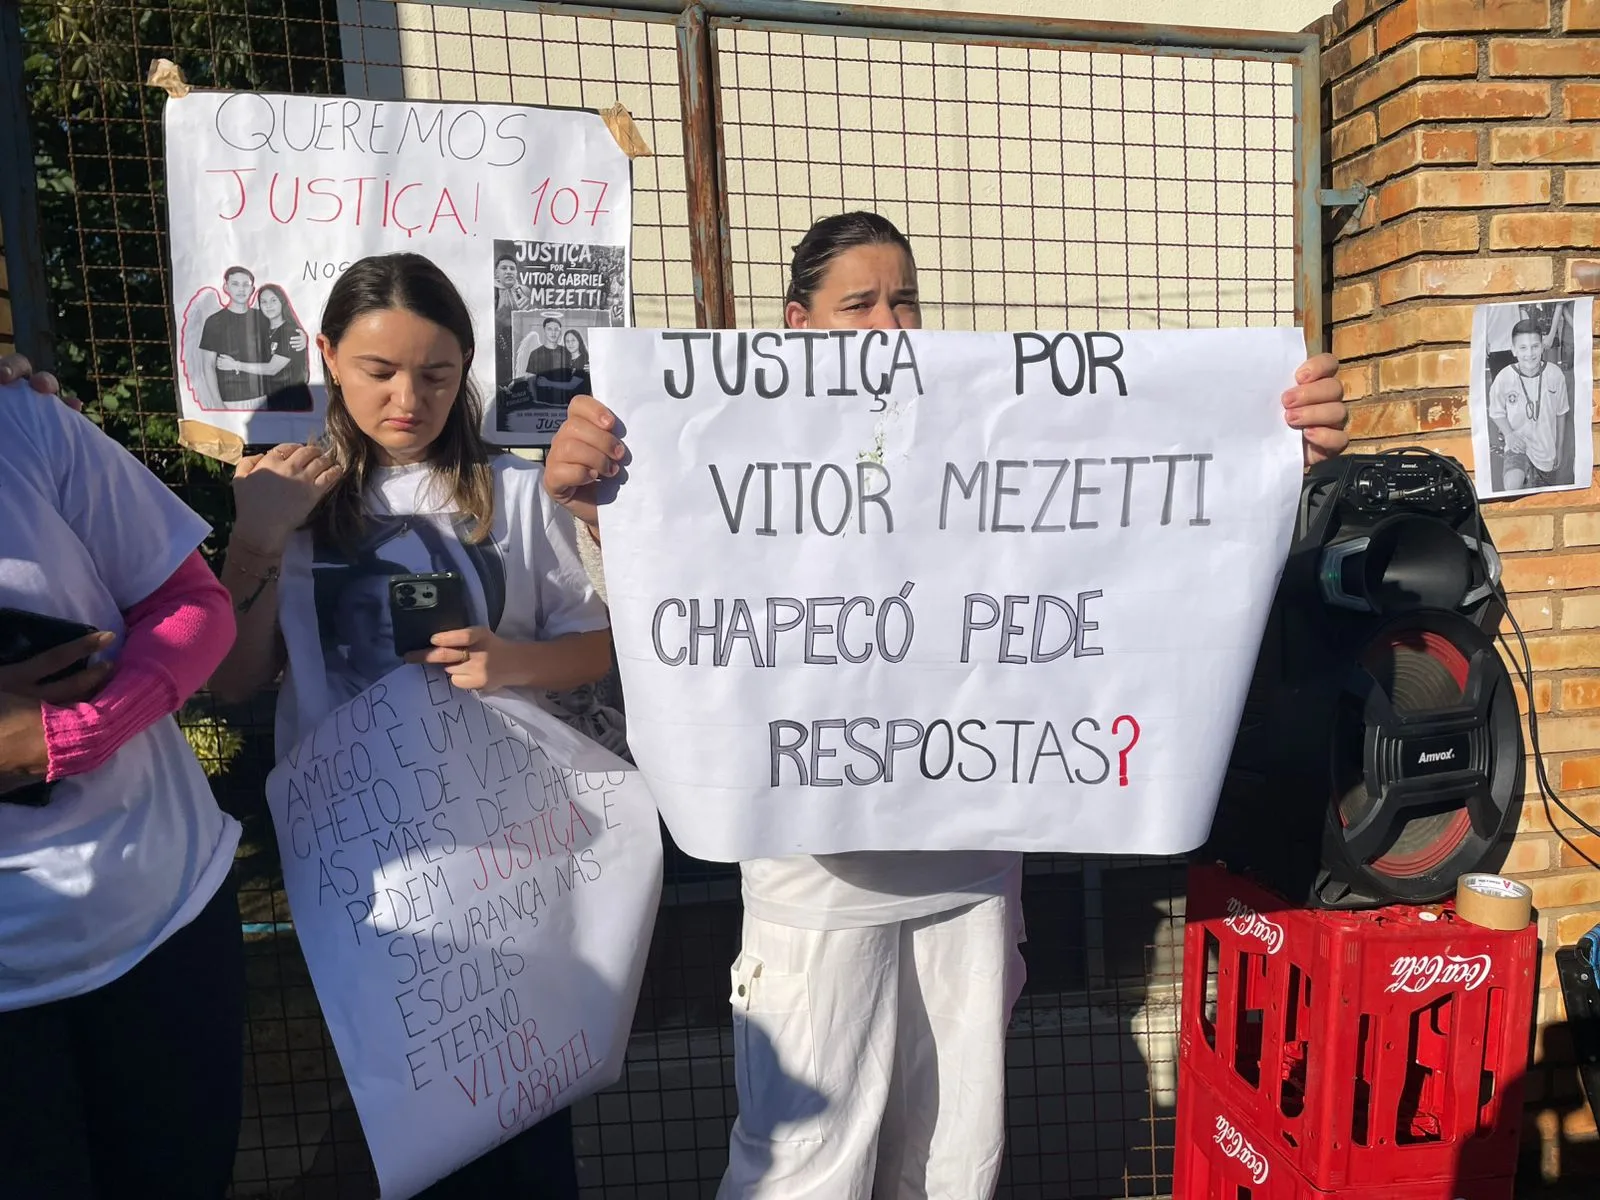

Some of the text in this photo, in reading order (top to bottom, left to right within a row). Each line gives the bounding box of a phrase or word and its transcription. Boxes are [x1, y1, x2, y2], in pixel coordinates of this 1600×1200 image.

[215, 92, 528, 167] QUEREMOS
[531, 177, 611, 227] 107
[515, 241, 592, 267] JUSTIÇA
[519, 271, 605, 287] VITOR GABRIEL
[550, 263, 564, 272] POR
[530, 287, 602, 306] MEZETTI
[664, 331, 1128, 412] JUSTIÇA POR
[708, 453, 1214, 536] VITOR MEZETTI
[651, 581, 1104, 668] CHAPECÓ PEDE
[286, 741, 372, 824] AMIGO
[386, 723, 416, 768] E
[421, 704, 472, 754] UM
[769, 714, 1141, 787] RESPOSTAS?
[1418, 748, 1455, 764] Amvox
[291, 732, 550, 860] CHEIO DE VIDA
[317, 849, 359, 907] AS
[374, 812, 457, 880] MÃES
[476, 788, 517, 838] DE
[345, 789, 622, 946] PEDEM JUSTIÇA E
[388, 848, 602, 985] SEGURANÇA NAS
[1223, 896, 1285, 955] Coca-Cola
[395, 936, 525, 1040] ESCOLAS
[1384, 953, 1493, 993] Coca-Cola
[453, 1018, 546, 1107] VITOR
[497, 1028, 603, 1131] GABRIEL
[1213, 1113, 1270, 1185] Coca-Cola
